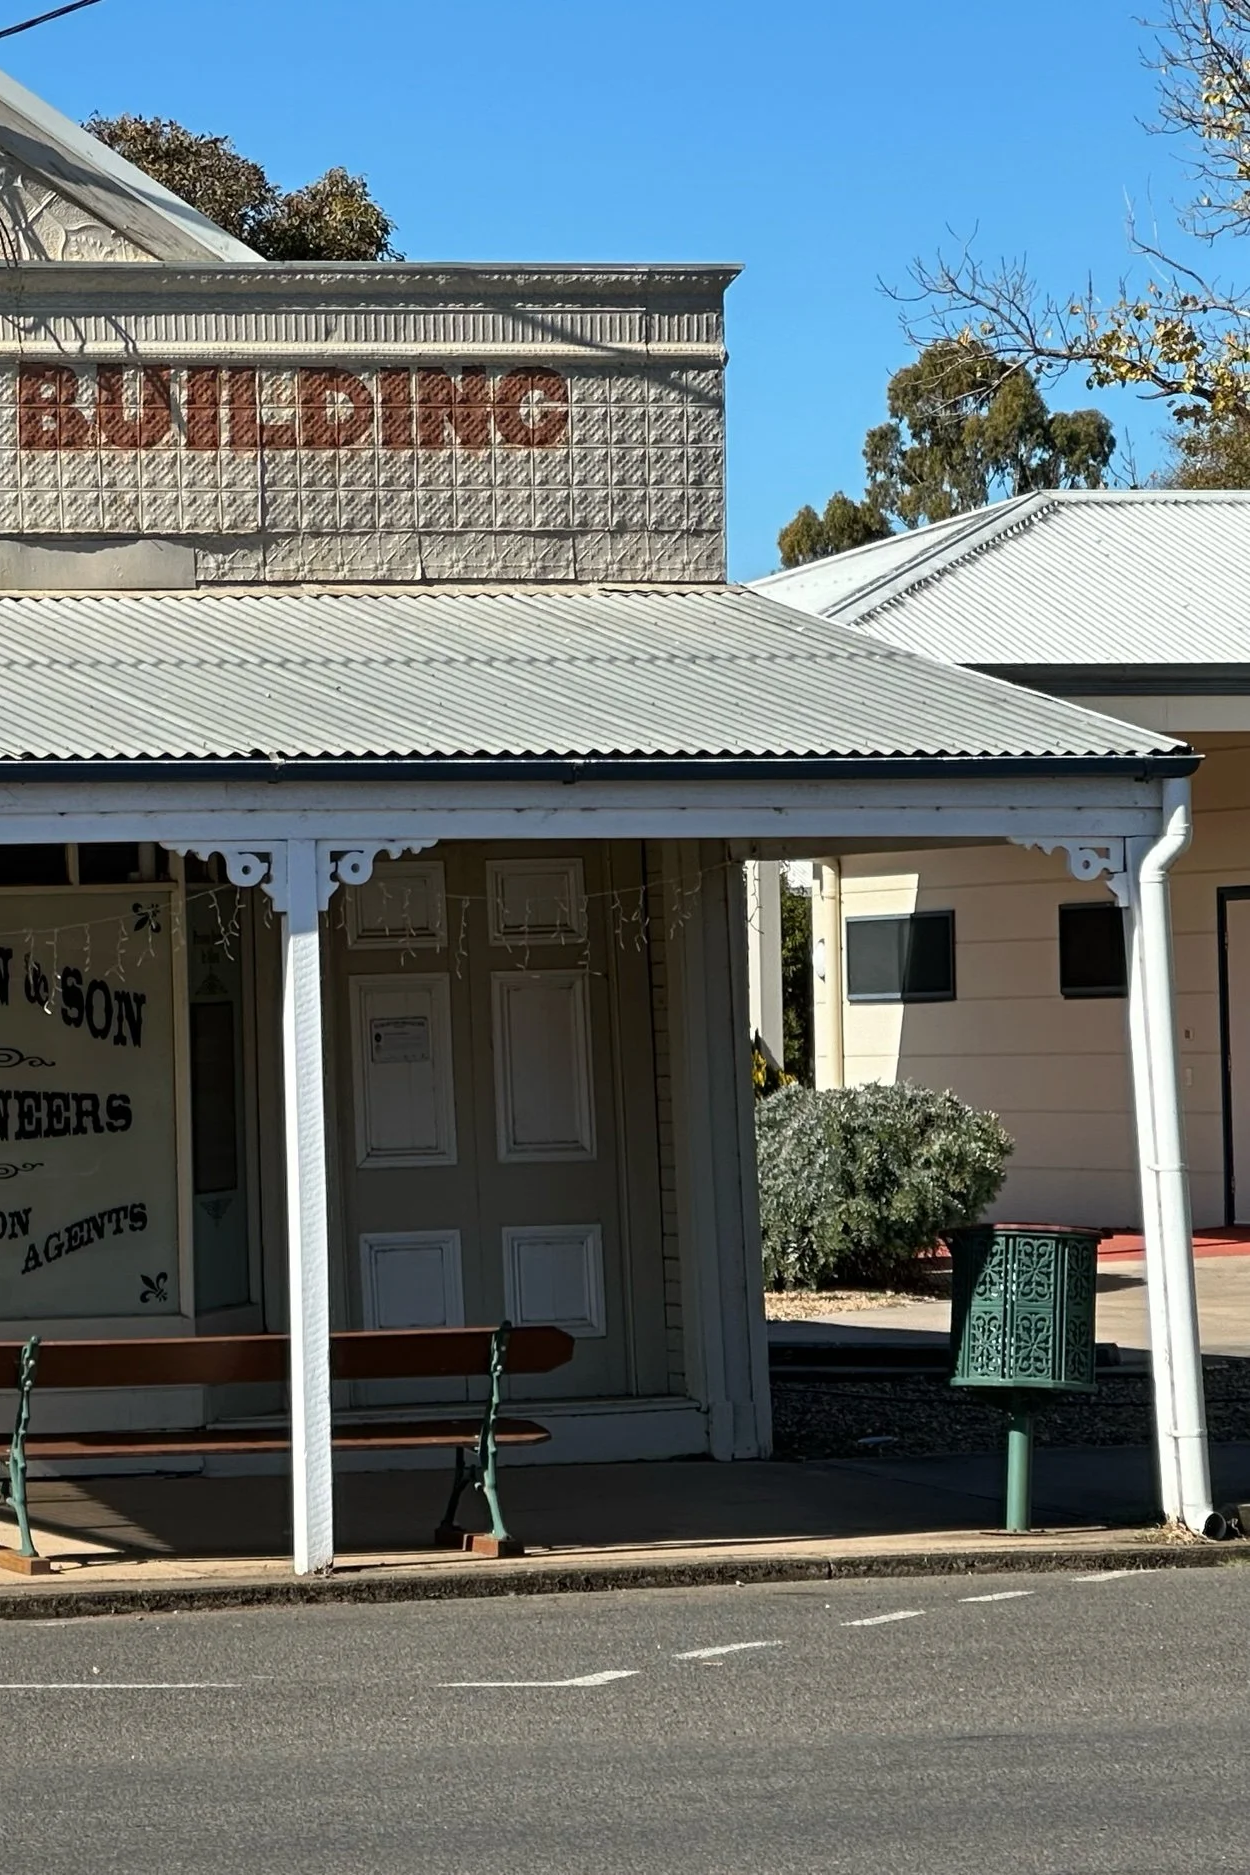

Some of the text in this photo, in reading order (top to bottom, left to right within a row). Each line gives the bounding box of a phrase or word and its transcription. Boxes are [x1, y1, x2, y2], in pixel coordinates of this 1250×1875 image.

[19, 363, 570, 450] BUILDING
[24, 952, 49, 1004] &
[61, 966, 146, 1048] SON
[21, 1203, 147, 1275] AGENTS
